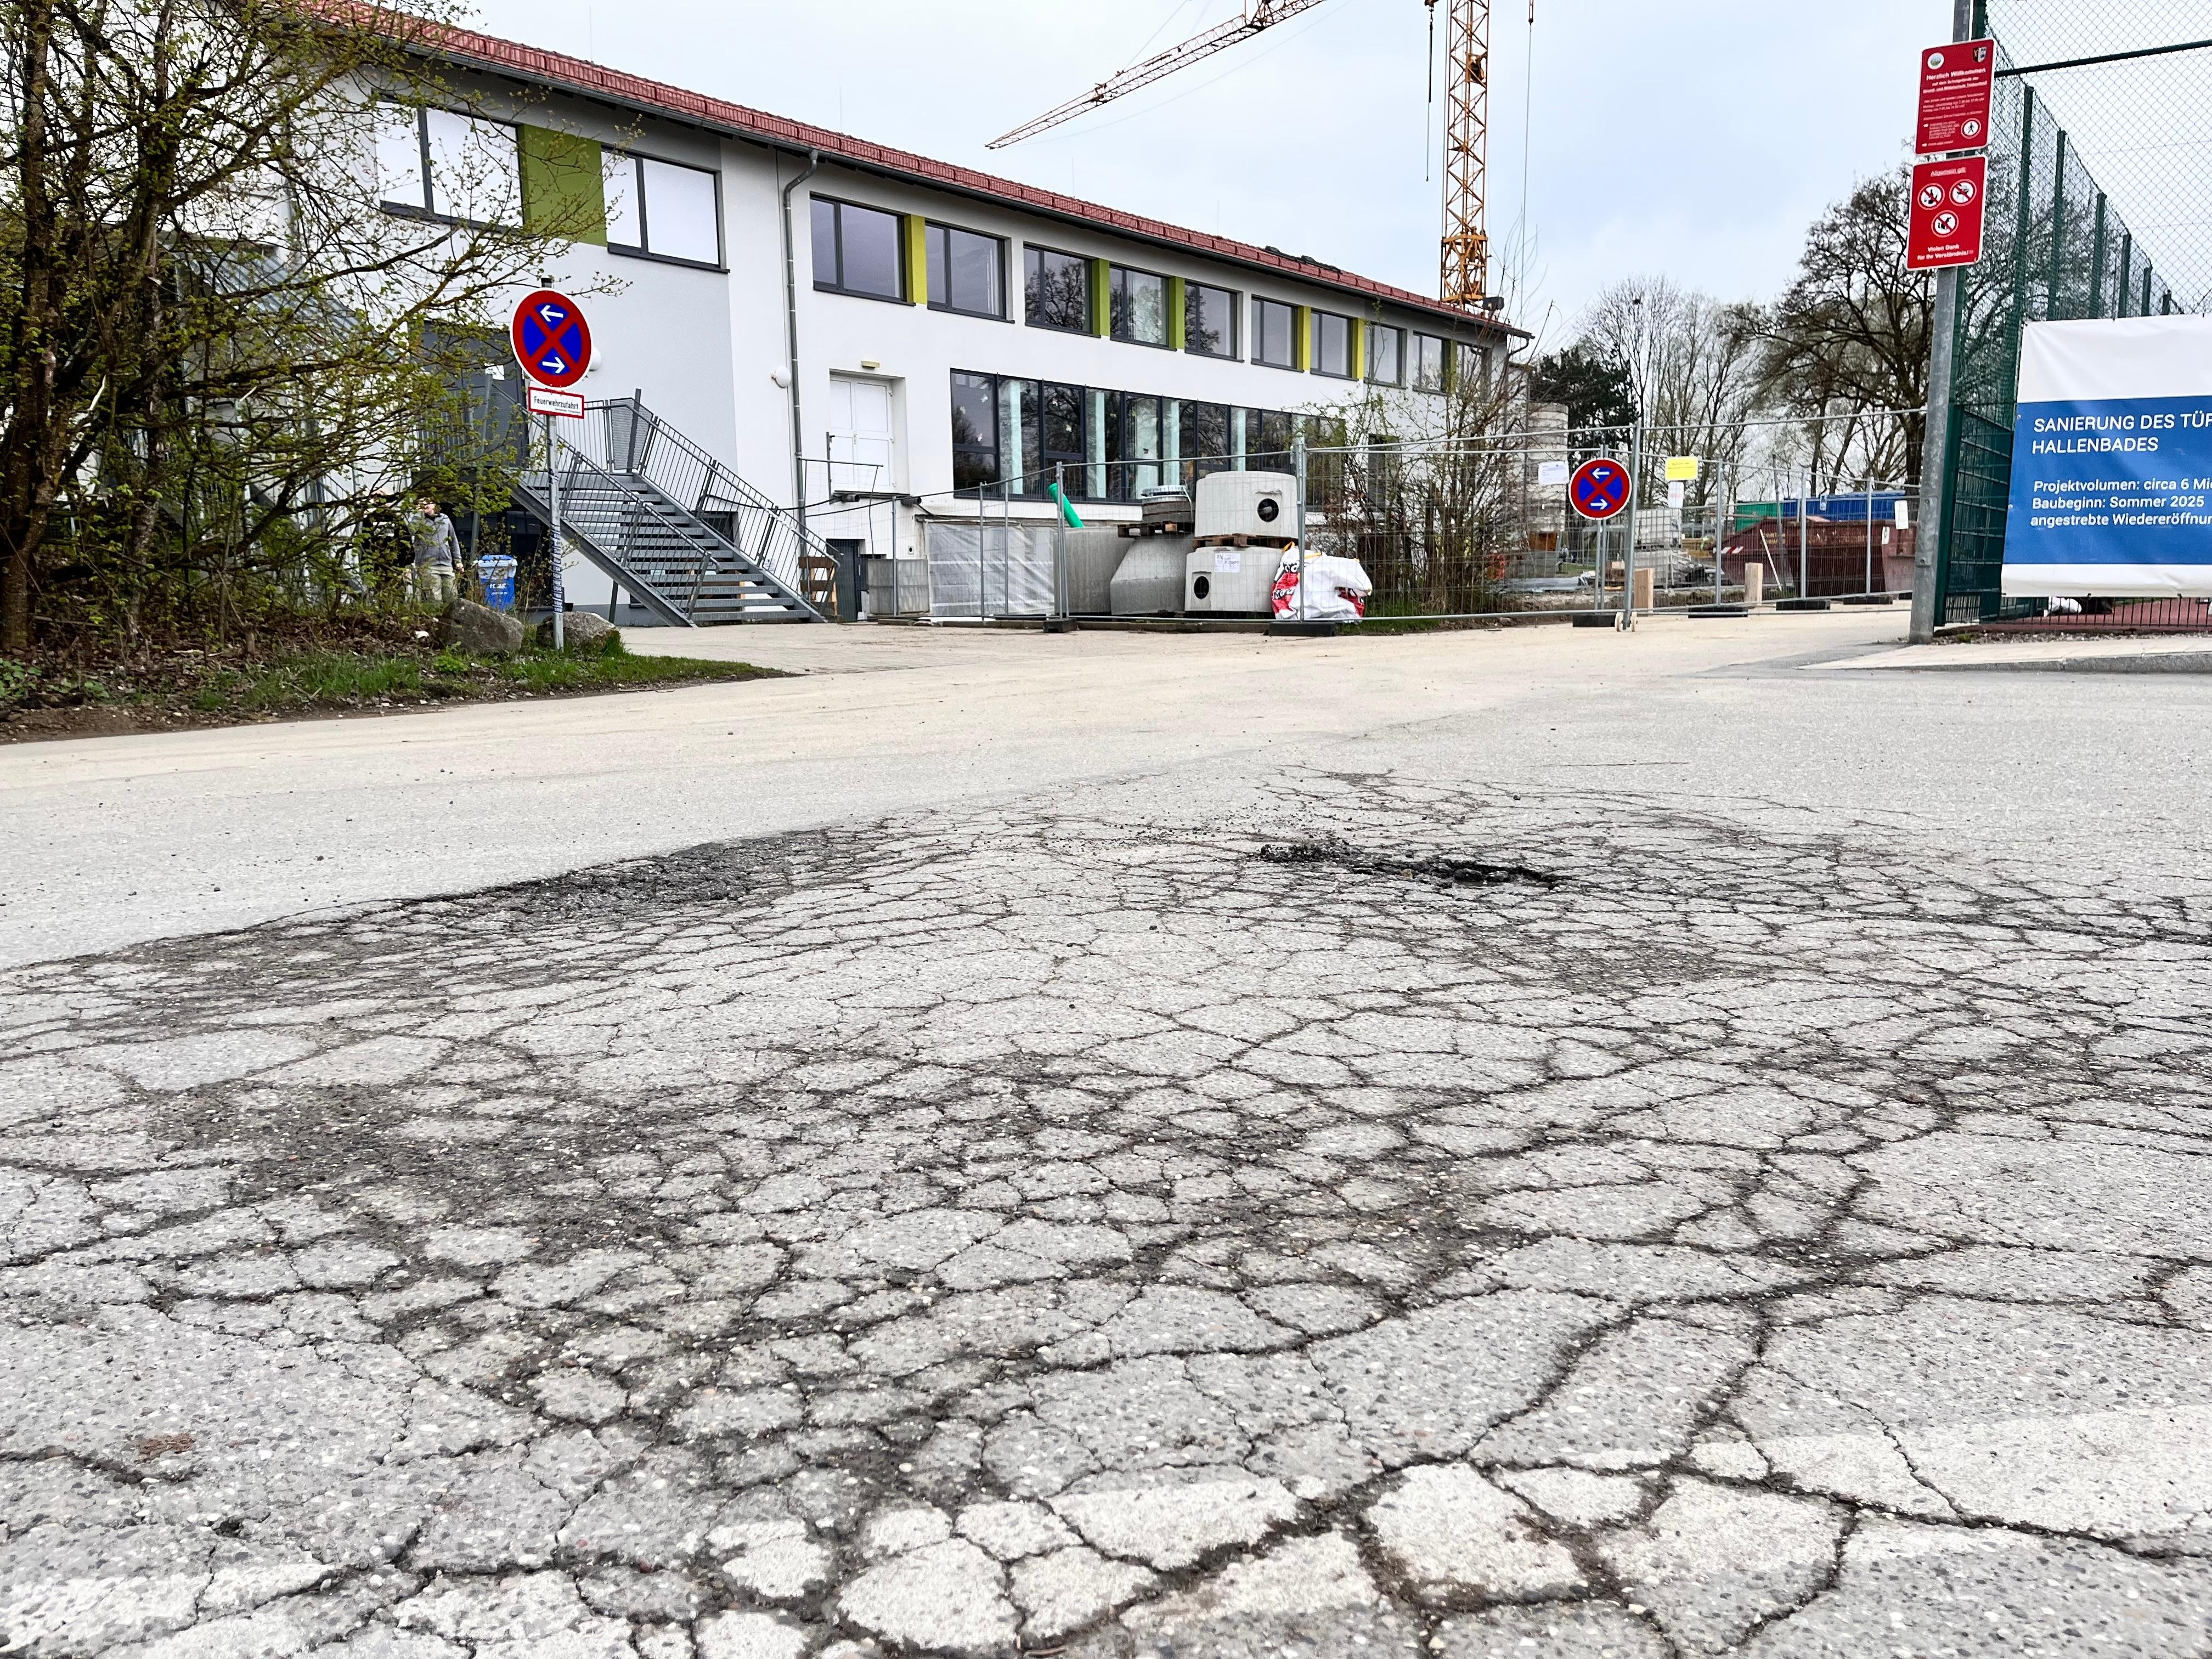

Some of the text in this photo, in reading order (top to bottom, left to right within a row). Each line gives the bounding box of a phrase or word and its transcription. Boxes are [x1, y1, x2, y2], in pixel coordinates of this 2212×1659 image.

[1926, 67, 1987, 81] Herzlich Willkommen
[534, 396, 578, 410] Feuerwehrzufahrt
[2034, 415, 2135, 432] SANIERUNG
[2140, 414, 2175, 429] DES
[2032, 437, 2159, 454] HALLENBADES
[2034, 477, 2212, 495] Projektvolumen: circa 6 Mi
[2032, 495, 2204, 511] Baubeginn: Sommer 2025
[2030, 514, 2109, 528] angestrebte
